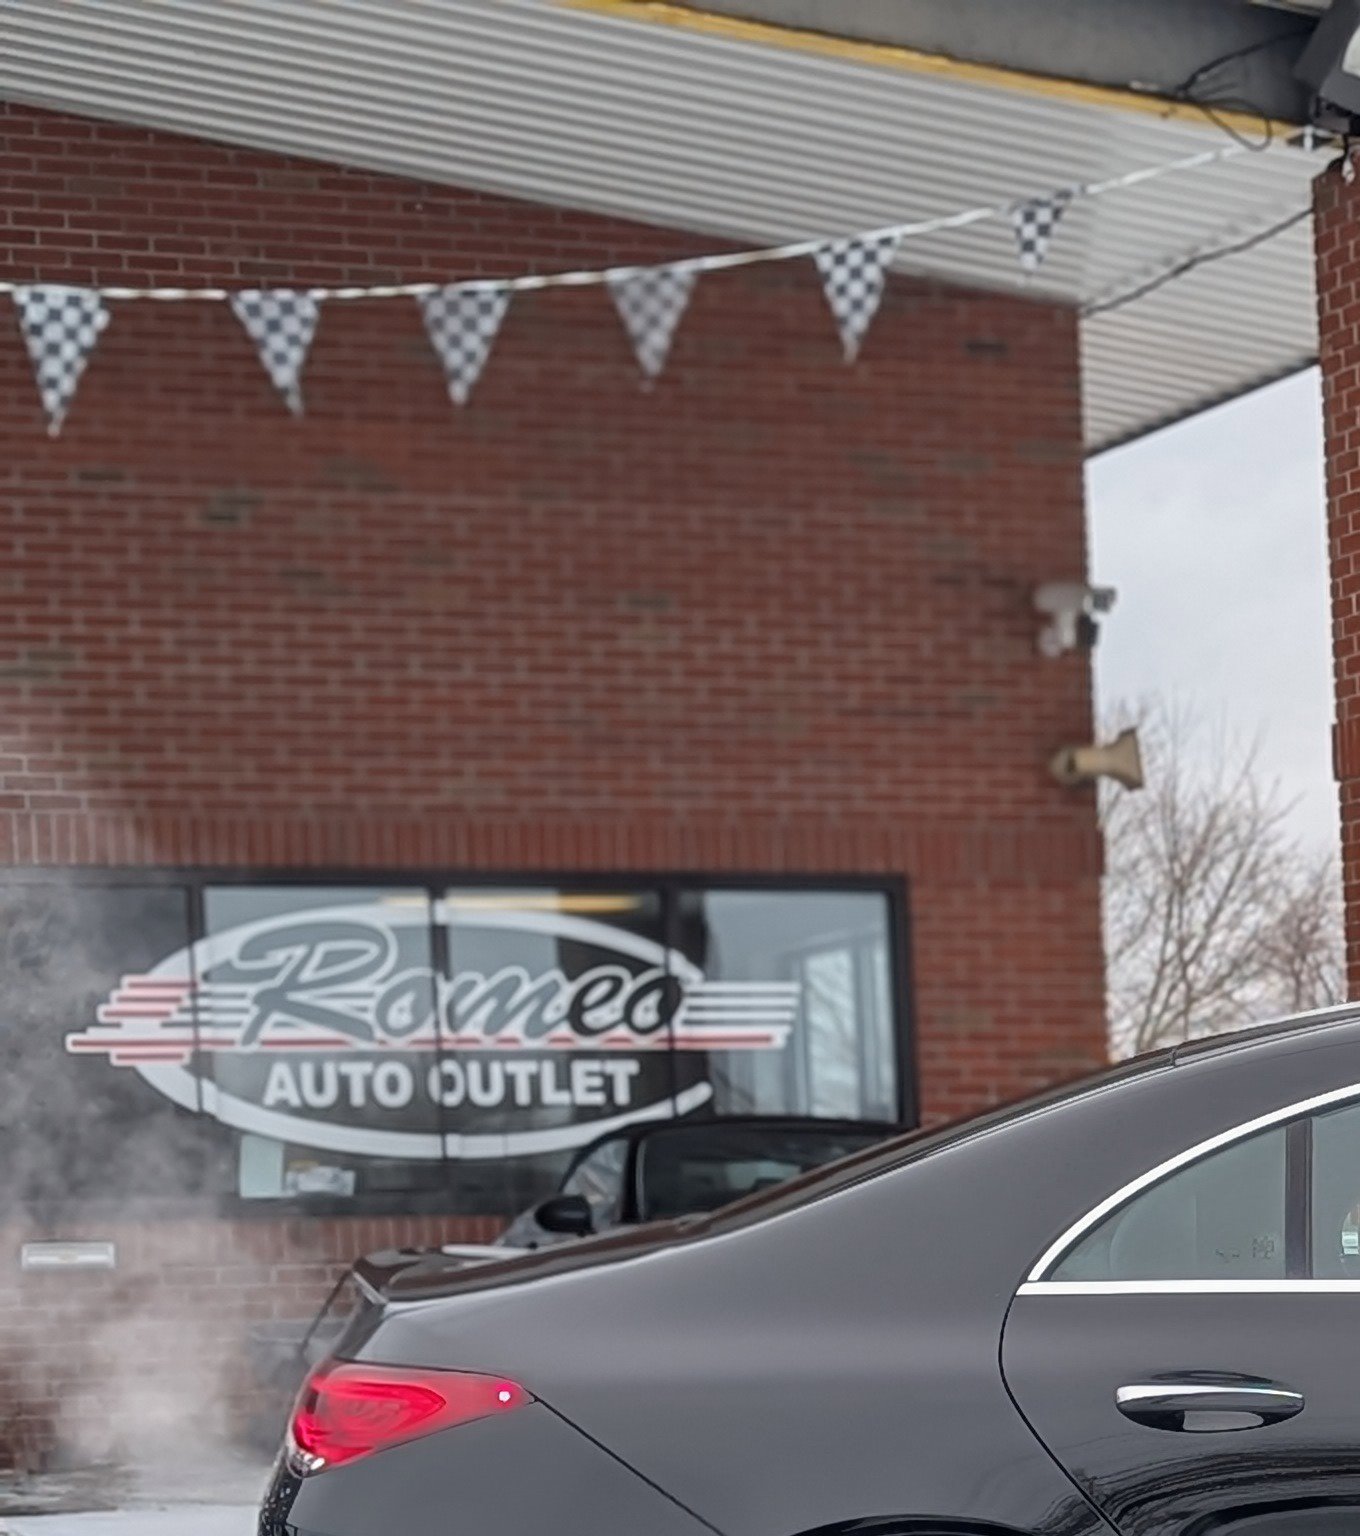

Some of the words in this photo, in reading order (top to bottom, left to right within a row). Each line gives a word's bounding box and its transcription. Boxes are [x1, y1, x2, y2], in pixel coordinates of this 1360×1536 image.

[231, 918, 685, 1052] Romeo
[262, 1060, 414, 1108] AUTO
[427, 1058, 641, 1108] OUTLET
